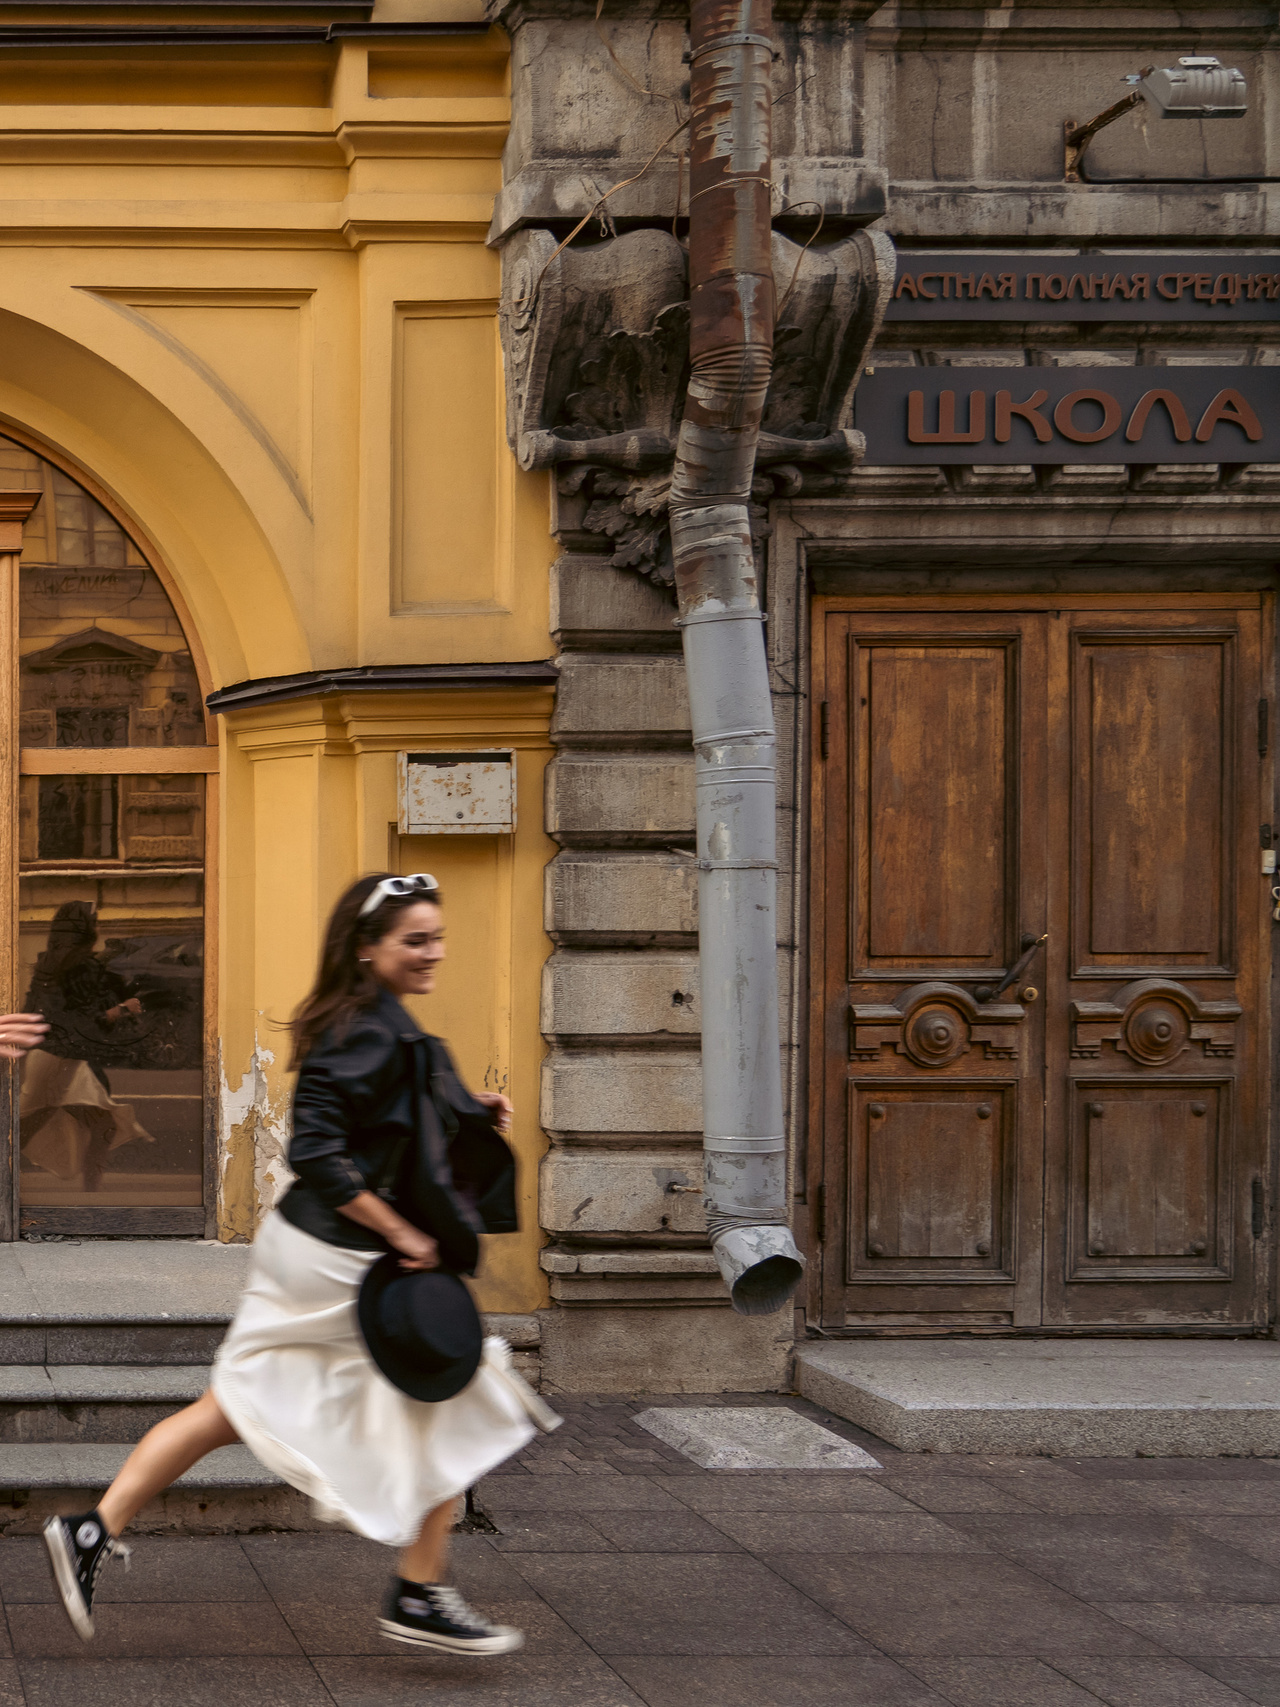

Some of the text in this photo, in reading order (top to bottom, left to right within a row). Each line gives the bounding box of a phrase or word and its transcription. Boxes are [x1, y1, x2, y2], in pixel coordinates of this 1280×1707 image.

[890, 272, 1017, 299] АСТНАЯ
[1025, 272, 1151, 299] ПОЛНАЯ
[907, 388, 1263, 443] ШКОЛА
